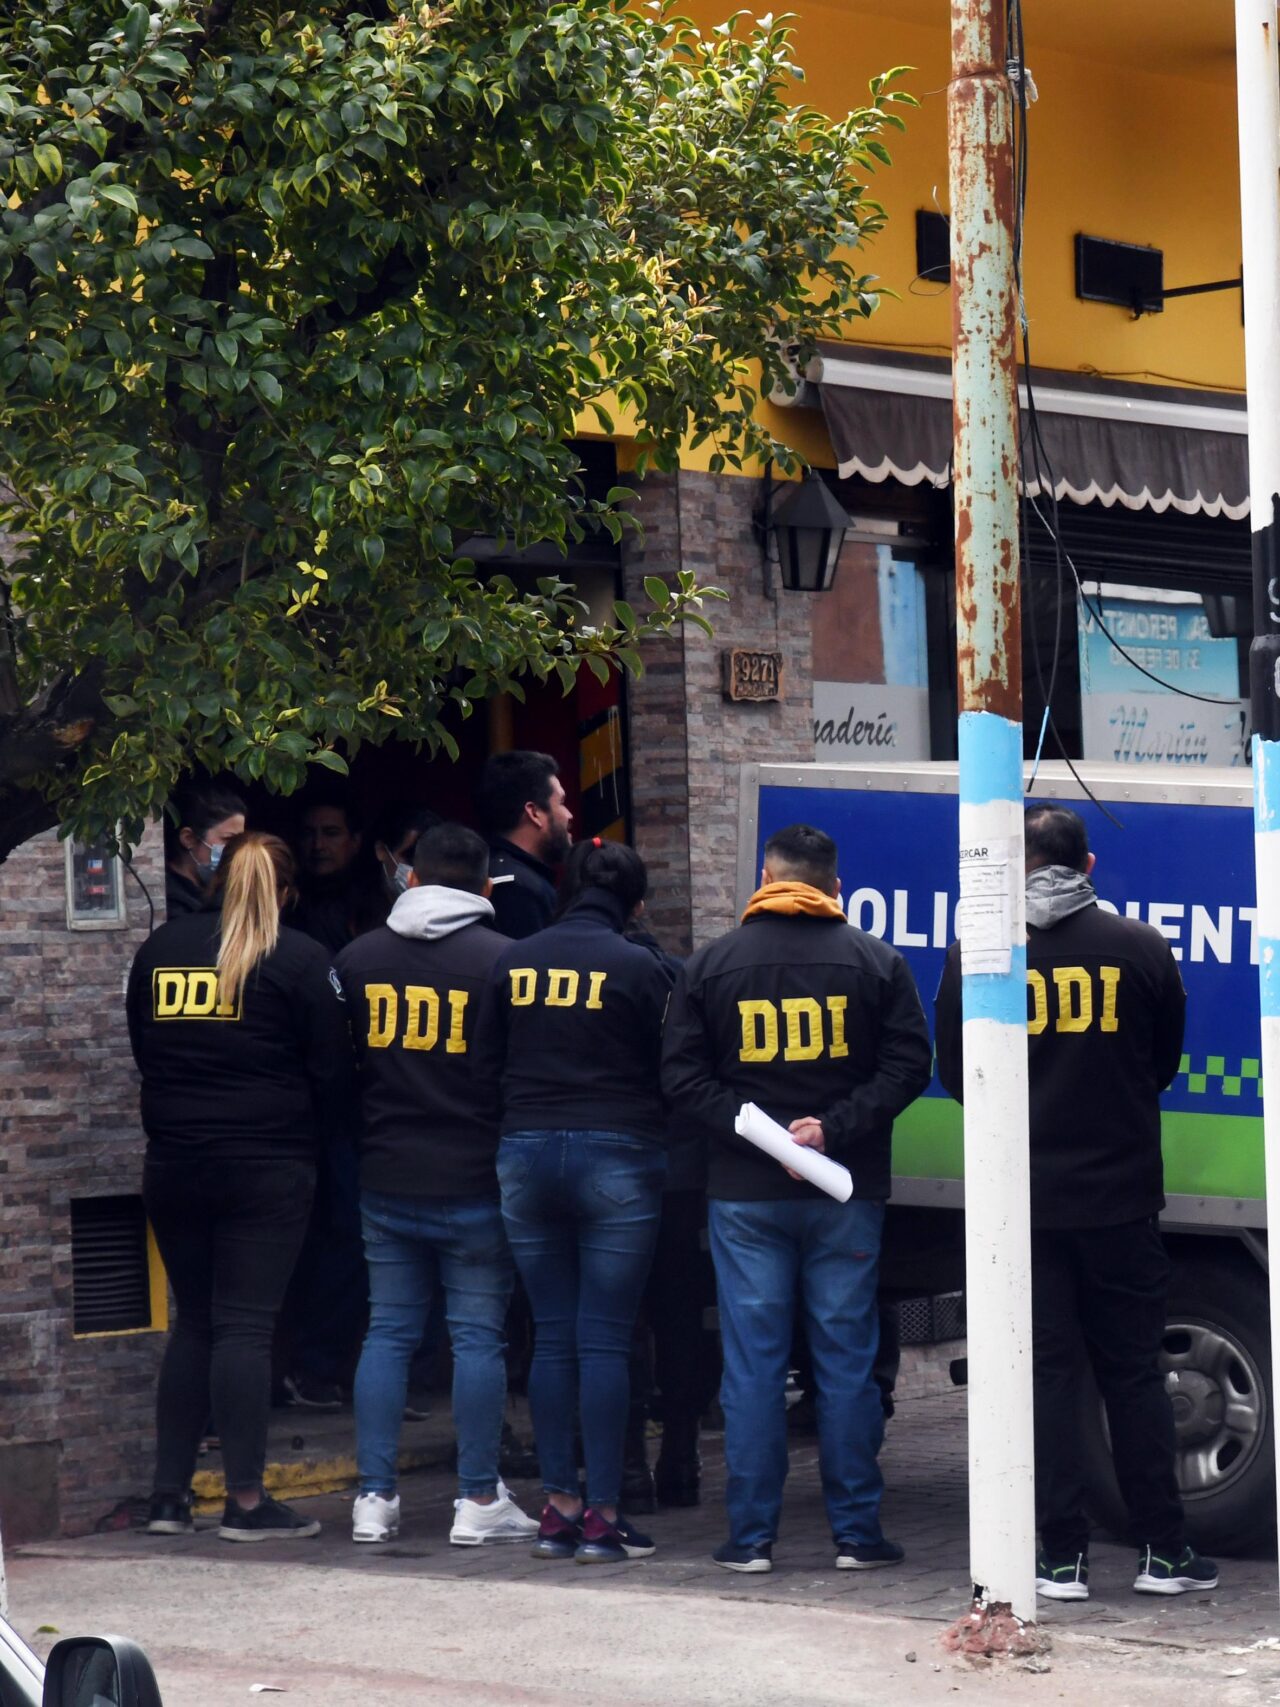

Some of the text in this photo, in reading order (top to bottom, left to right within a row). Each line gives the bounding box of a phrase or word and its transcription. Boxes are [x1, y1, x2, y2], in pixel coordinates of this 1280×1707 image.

[365, 983, 469, 1053] DDI
[508, 967, 607, 1010] DDI
[738, 995, 848, 1063] DDI
